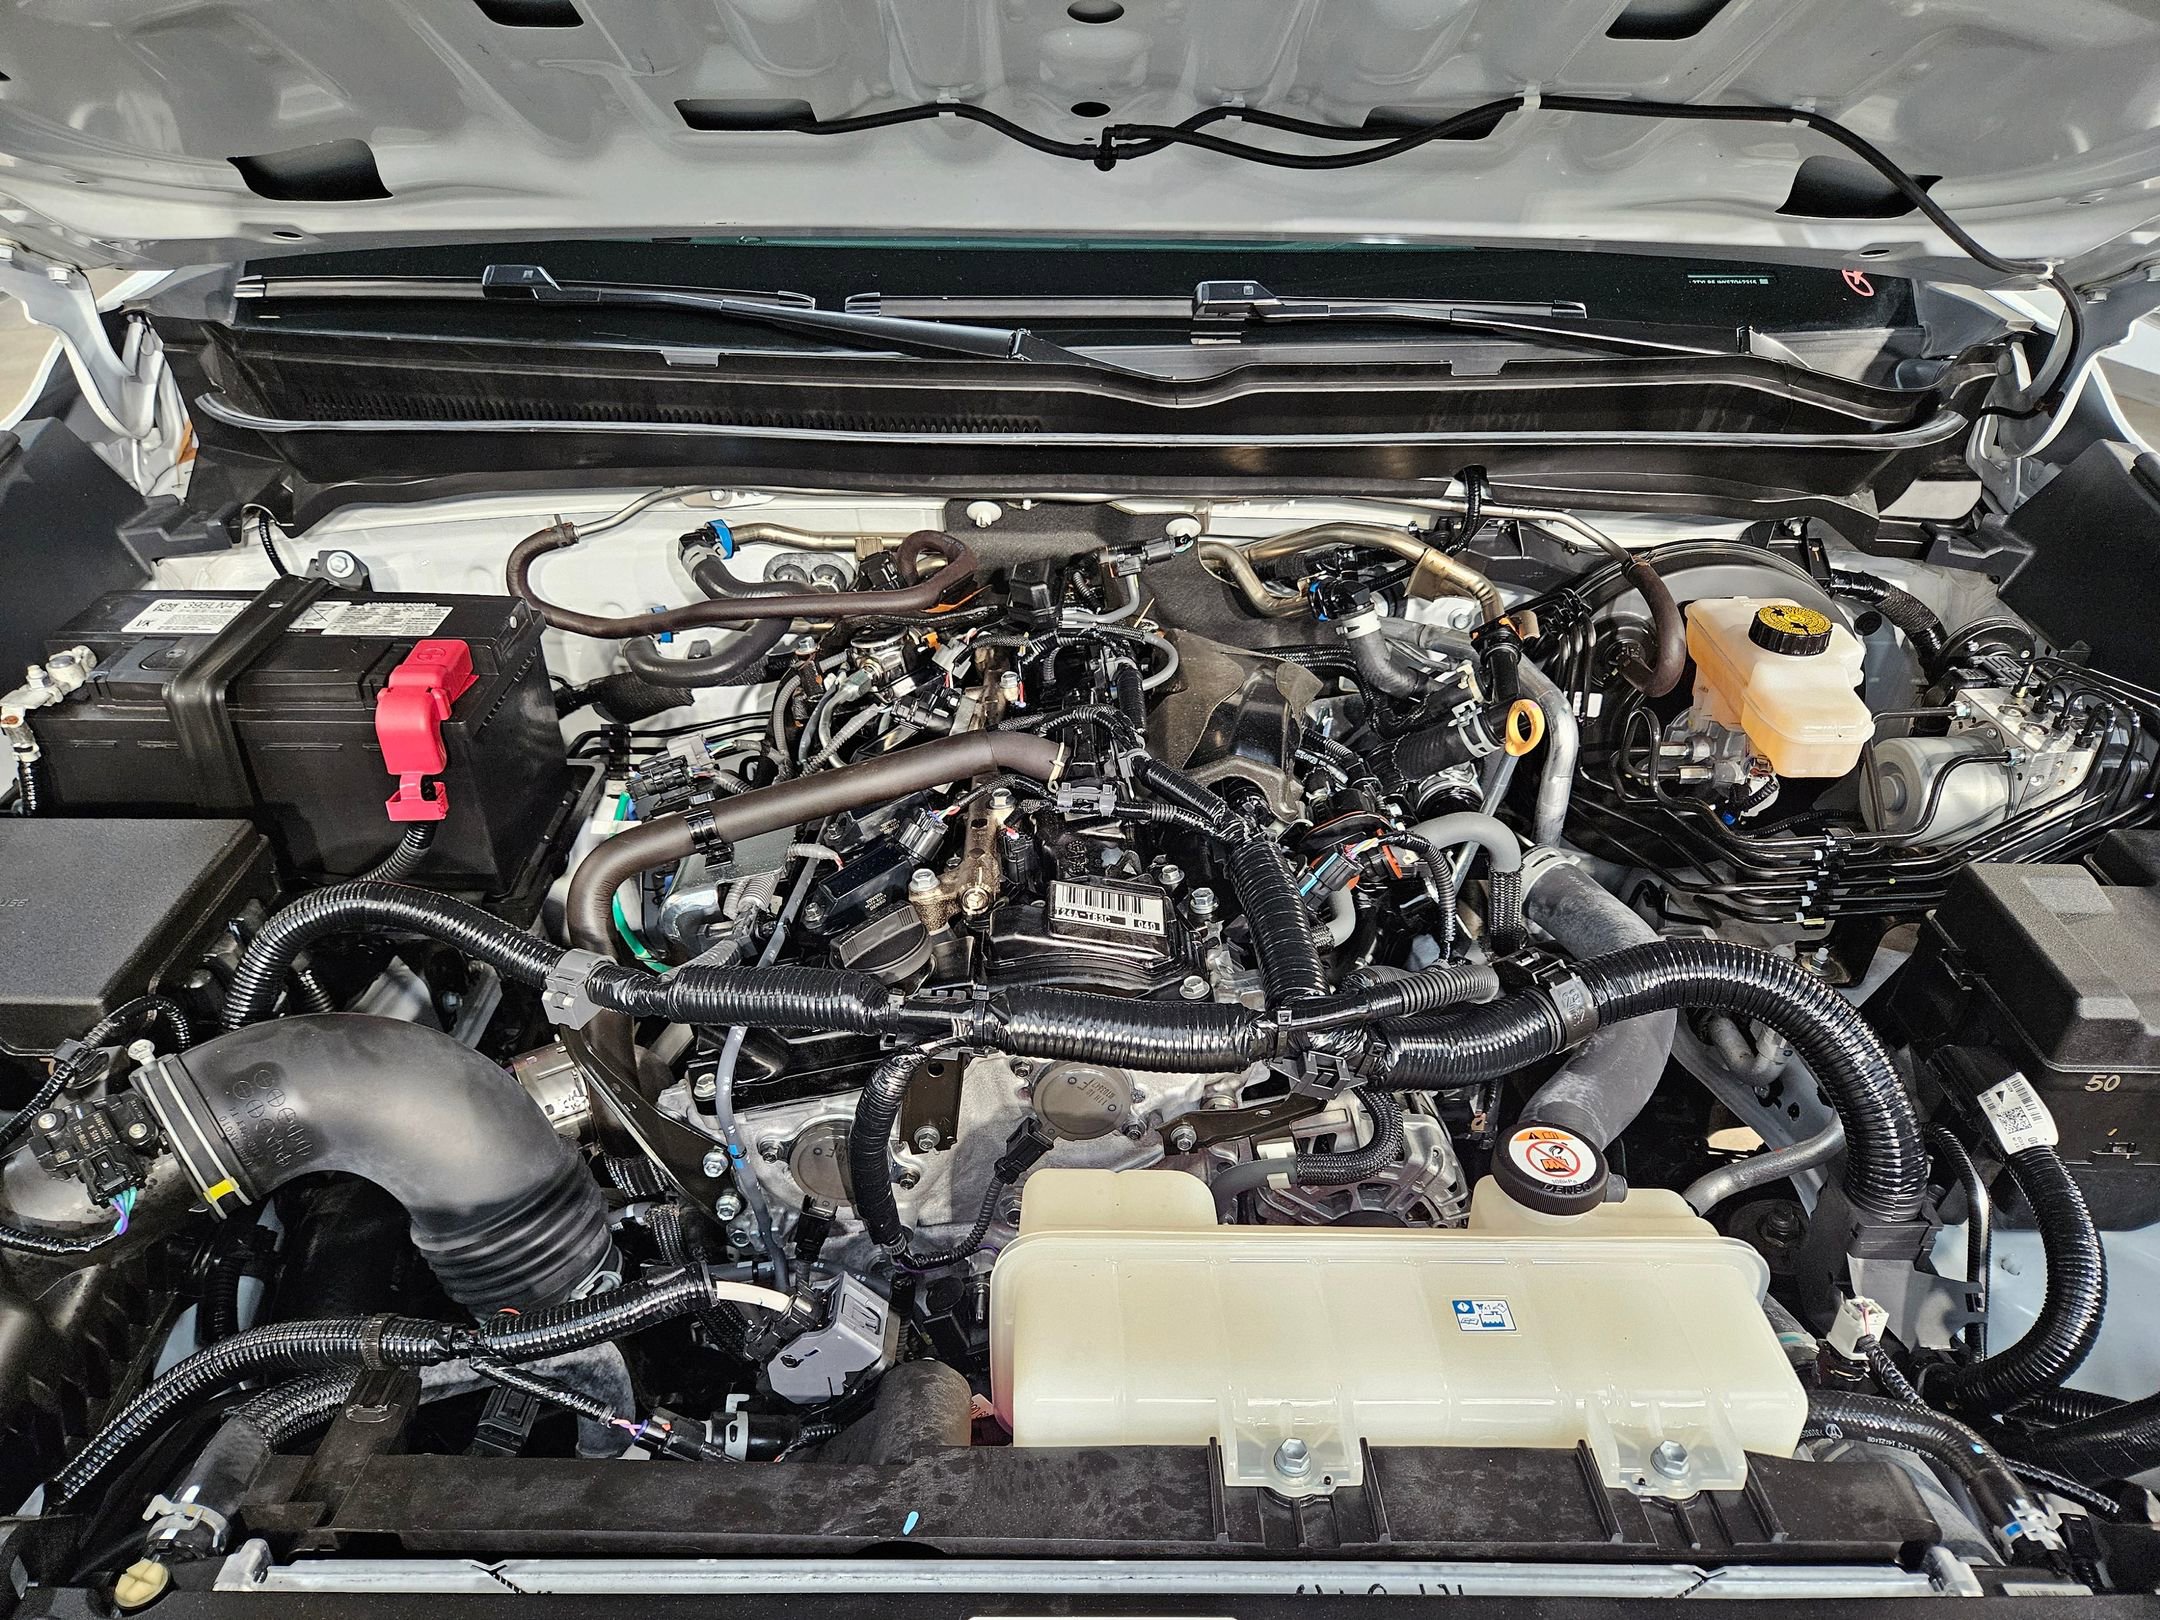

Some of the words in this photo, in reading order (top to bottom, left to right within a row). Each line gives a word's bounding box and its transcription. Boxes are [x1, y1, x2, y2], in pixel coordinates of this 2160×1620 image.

[1138, 921, 1156, 930] 040
[2085, 1074, 2121, 1092] 50
[1542, 1183, 1592, 1195] DENSO
